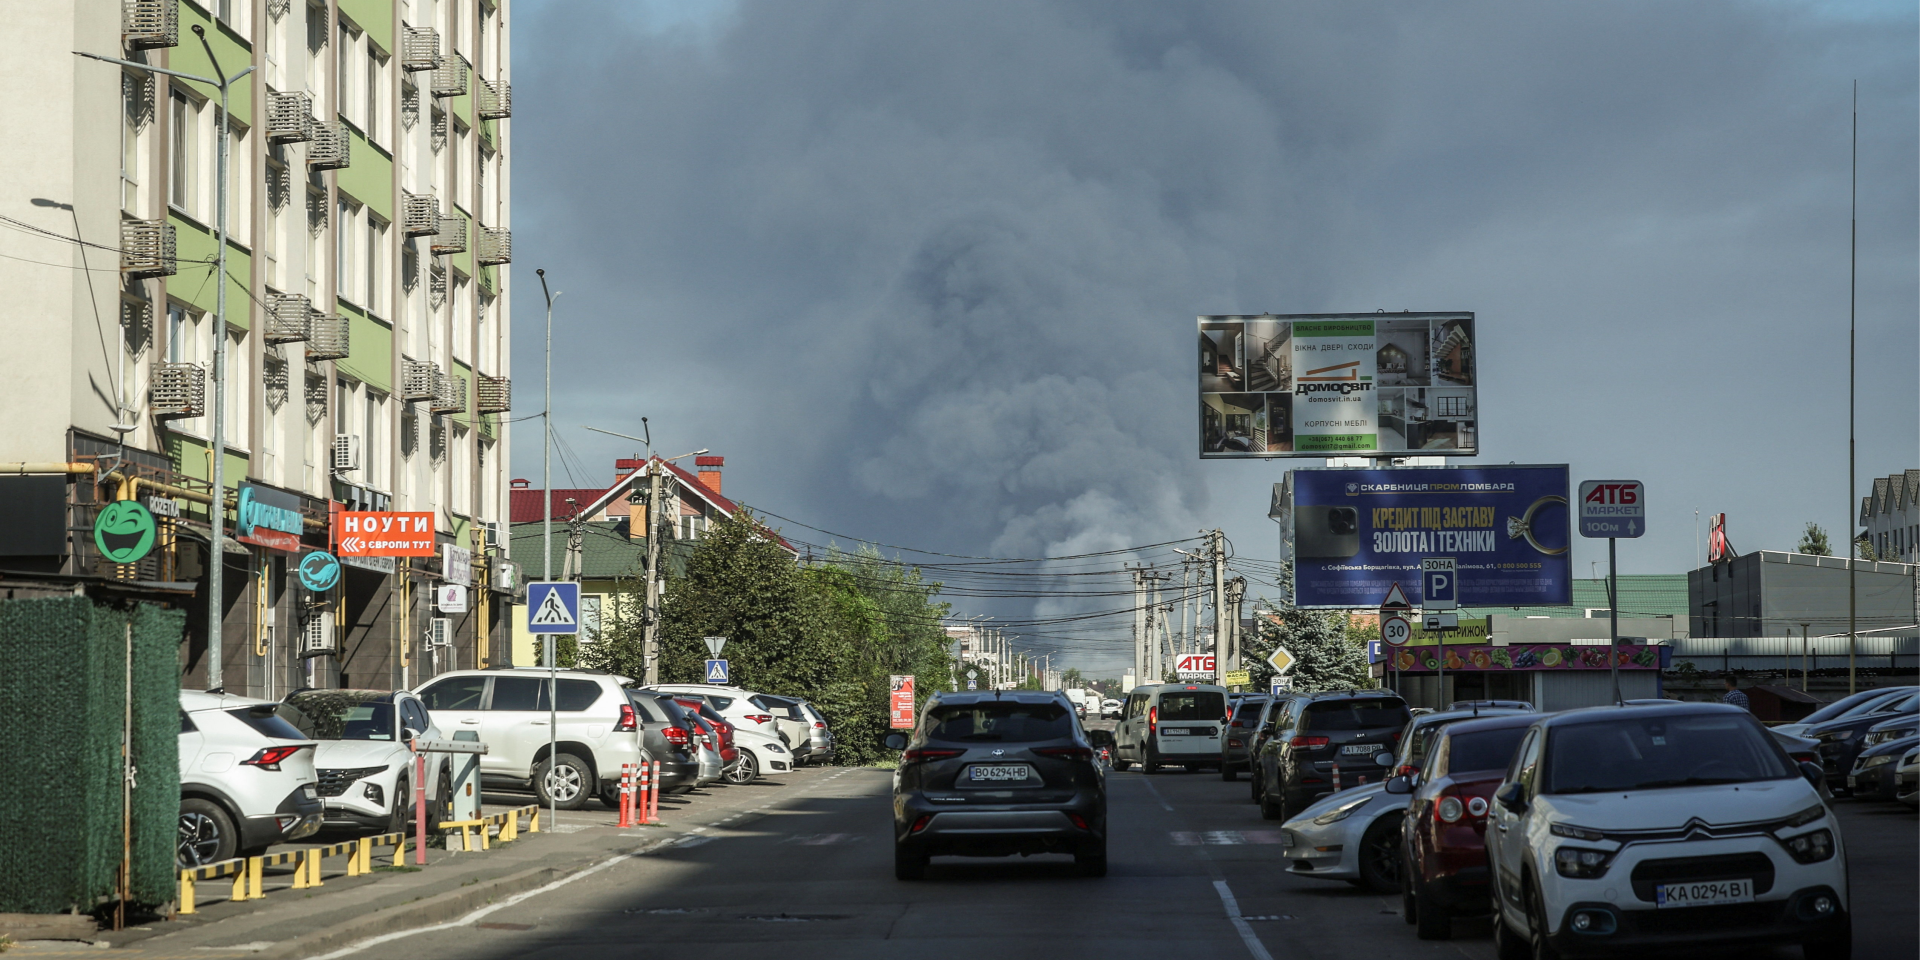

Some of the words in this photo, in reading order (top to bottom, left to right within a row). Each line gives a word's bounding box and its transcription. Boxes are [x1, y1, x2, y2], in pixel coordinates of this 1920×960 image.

[1586, 484, 1638, 504] АТБ
[150, 496, 180, 518] ROZETKA
[1587, 506, 1639, 515] МАРКЕТ
[345, 516, 428, 533] НОУТИ
[1372, 507, 1418, 531] КРЕДИТ
[1421, 507, 1442, 530] ПІД
[1443, 506, 1495, 528] ЗАСТАВУ
[1373, 531, 1428, 552] ЗОЛОТА
[1437, 531, 1495, 552] ТЕХНІКИ
[1424, 561, 1453, 570] ЗОНА
[1432, 575, 1448, 597] P
[1388, 626, 1404, 637] 30
[1448, 626, 1486, 638] СТРИЖОК
[976, 768, 988, 776] BO
[990, 768, 1012, 776] 6294
[1013, 768, 1026, 776] HB
[1666, 886, 1688, 902] KA
[1692, 884, 1728, 900] 0294
[1730, 882, 1748, 897] BI
